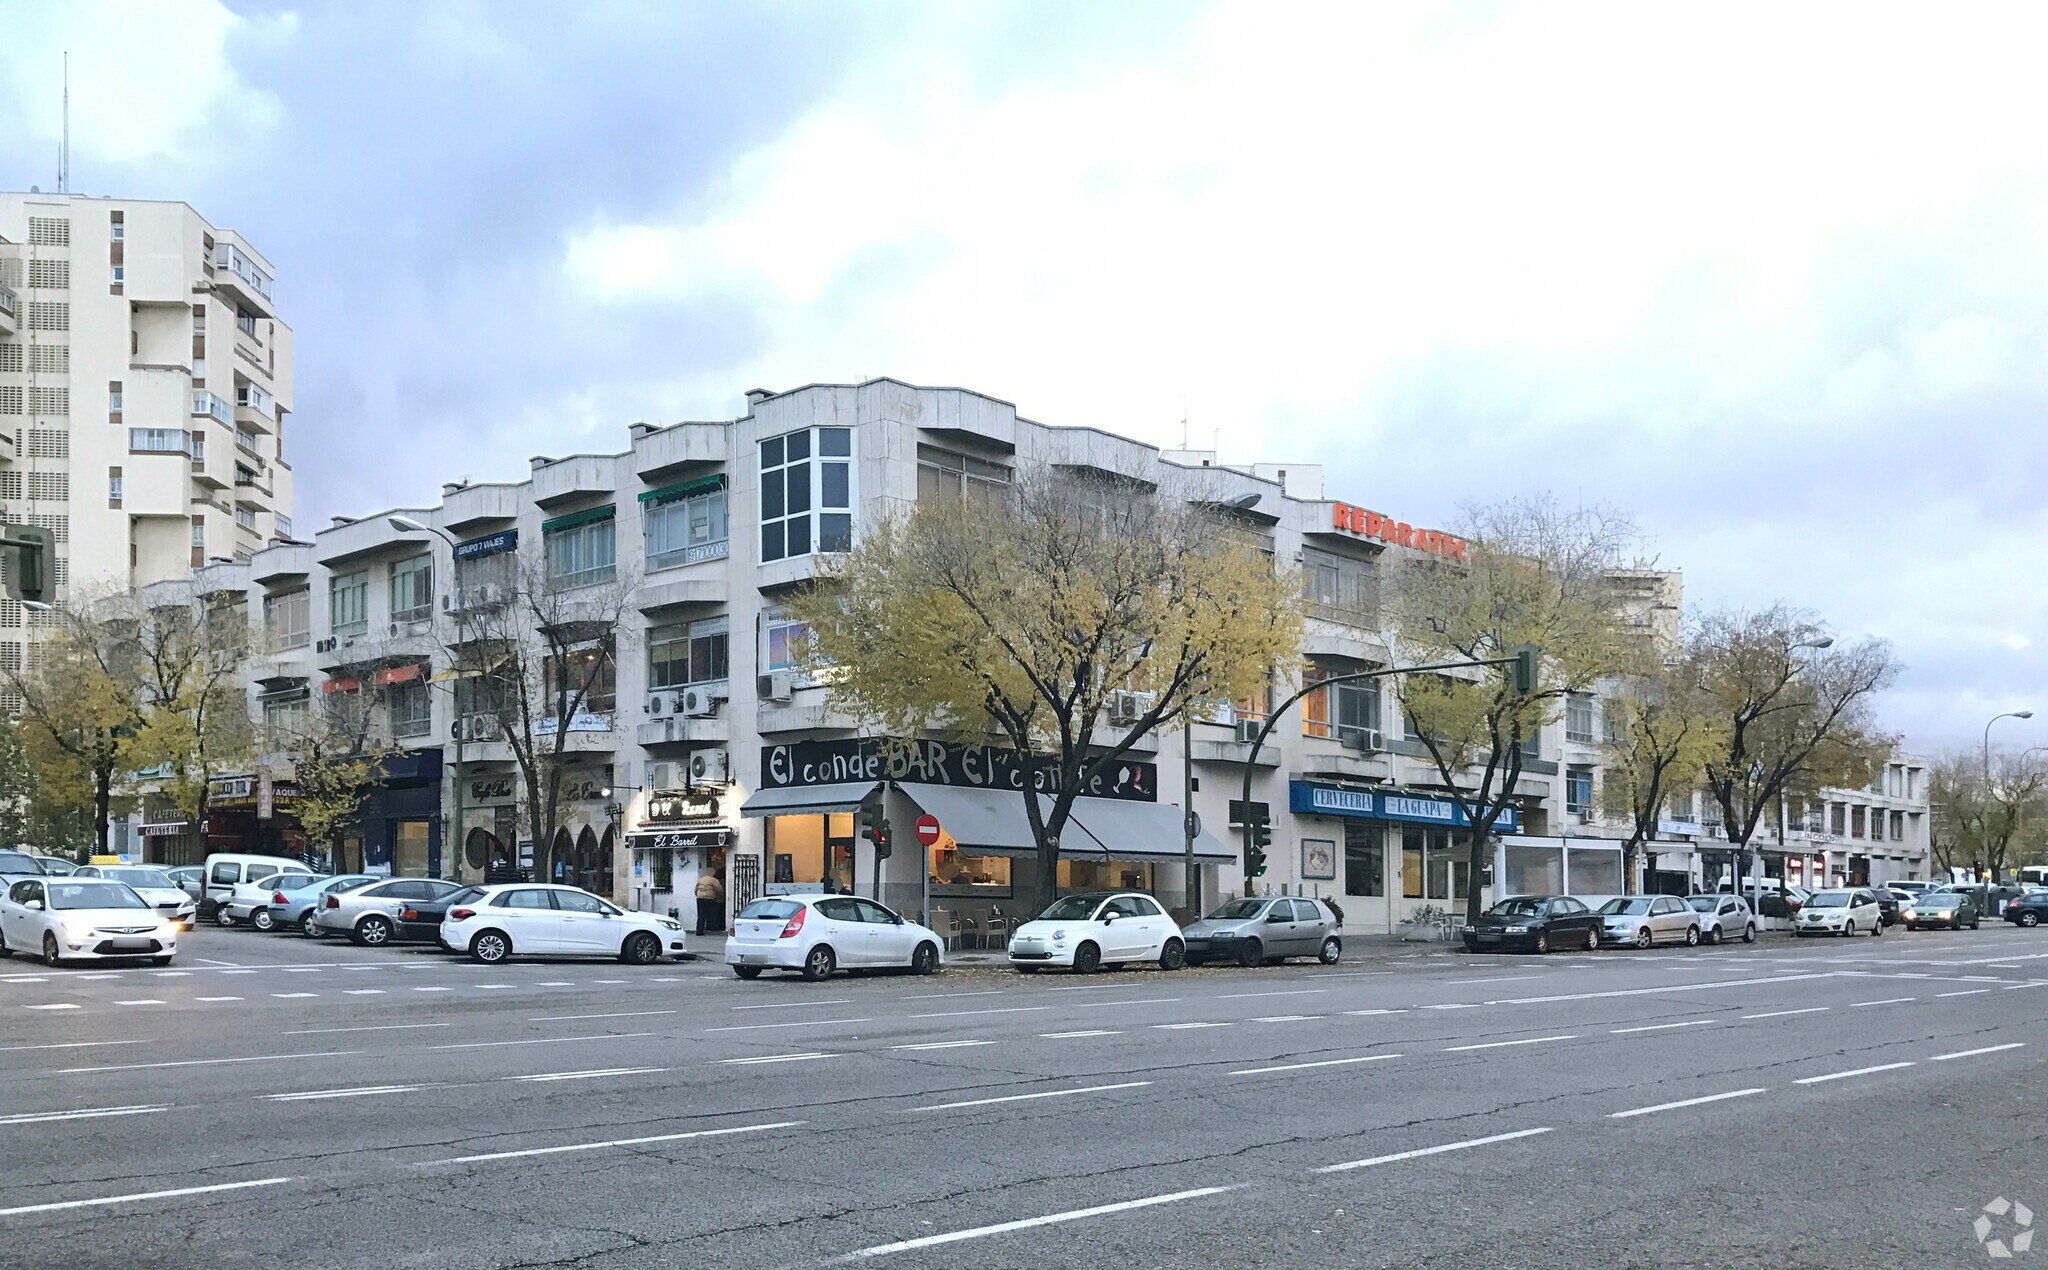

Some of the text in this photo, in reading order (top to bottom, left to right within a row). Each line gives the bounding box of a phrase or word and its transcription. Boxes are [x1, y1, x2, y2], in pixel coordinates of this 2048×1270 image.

[458, 542, 478, 555] GRUPO
[478, 542, 483, 550] 7
[769, 742, 879, 784] El conde
[887, 740, 951, 784] BAR
[961, 747, 1102, 795] El cone
[271, 788, 300, 797] VAQUE
[1315, 789, 1372, 809] CERVECERIA
[1397, 797, 1442, 817] LA GUAPA
[145, 825, 179, 836] CAFETERIA
[654, 834, 698, 848] El Barril
